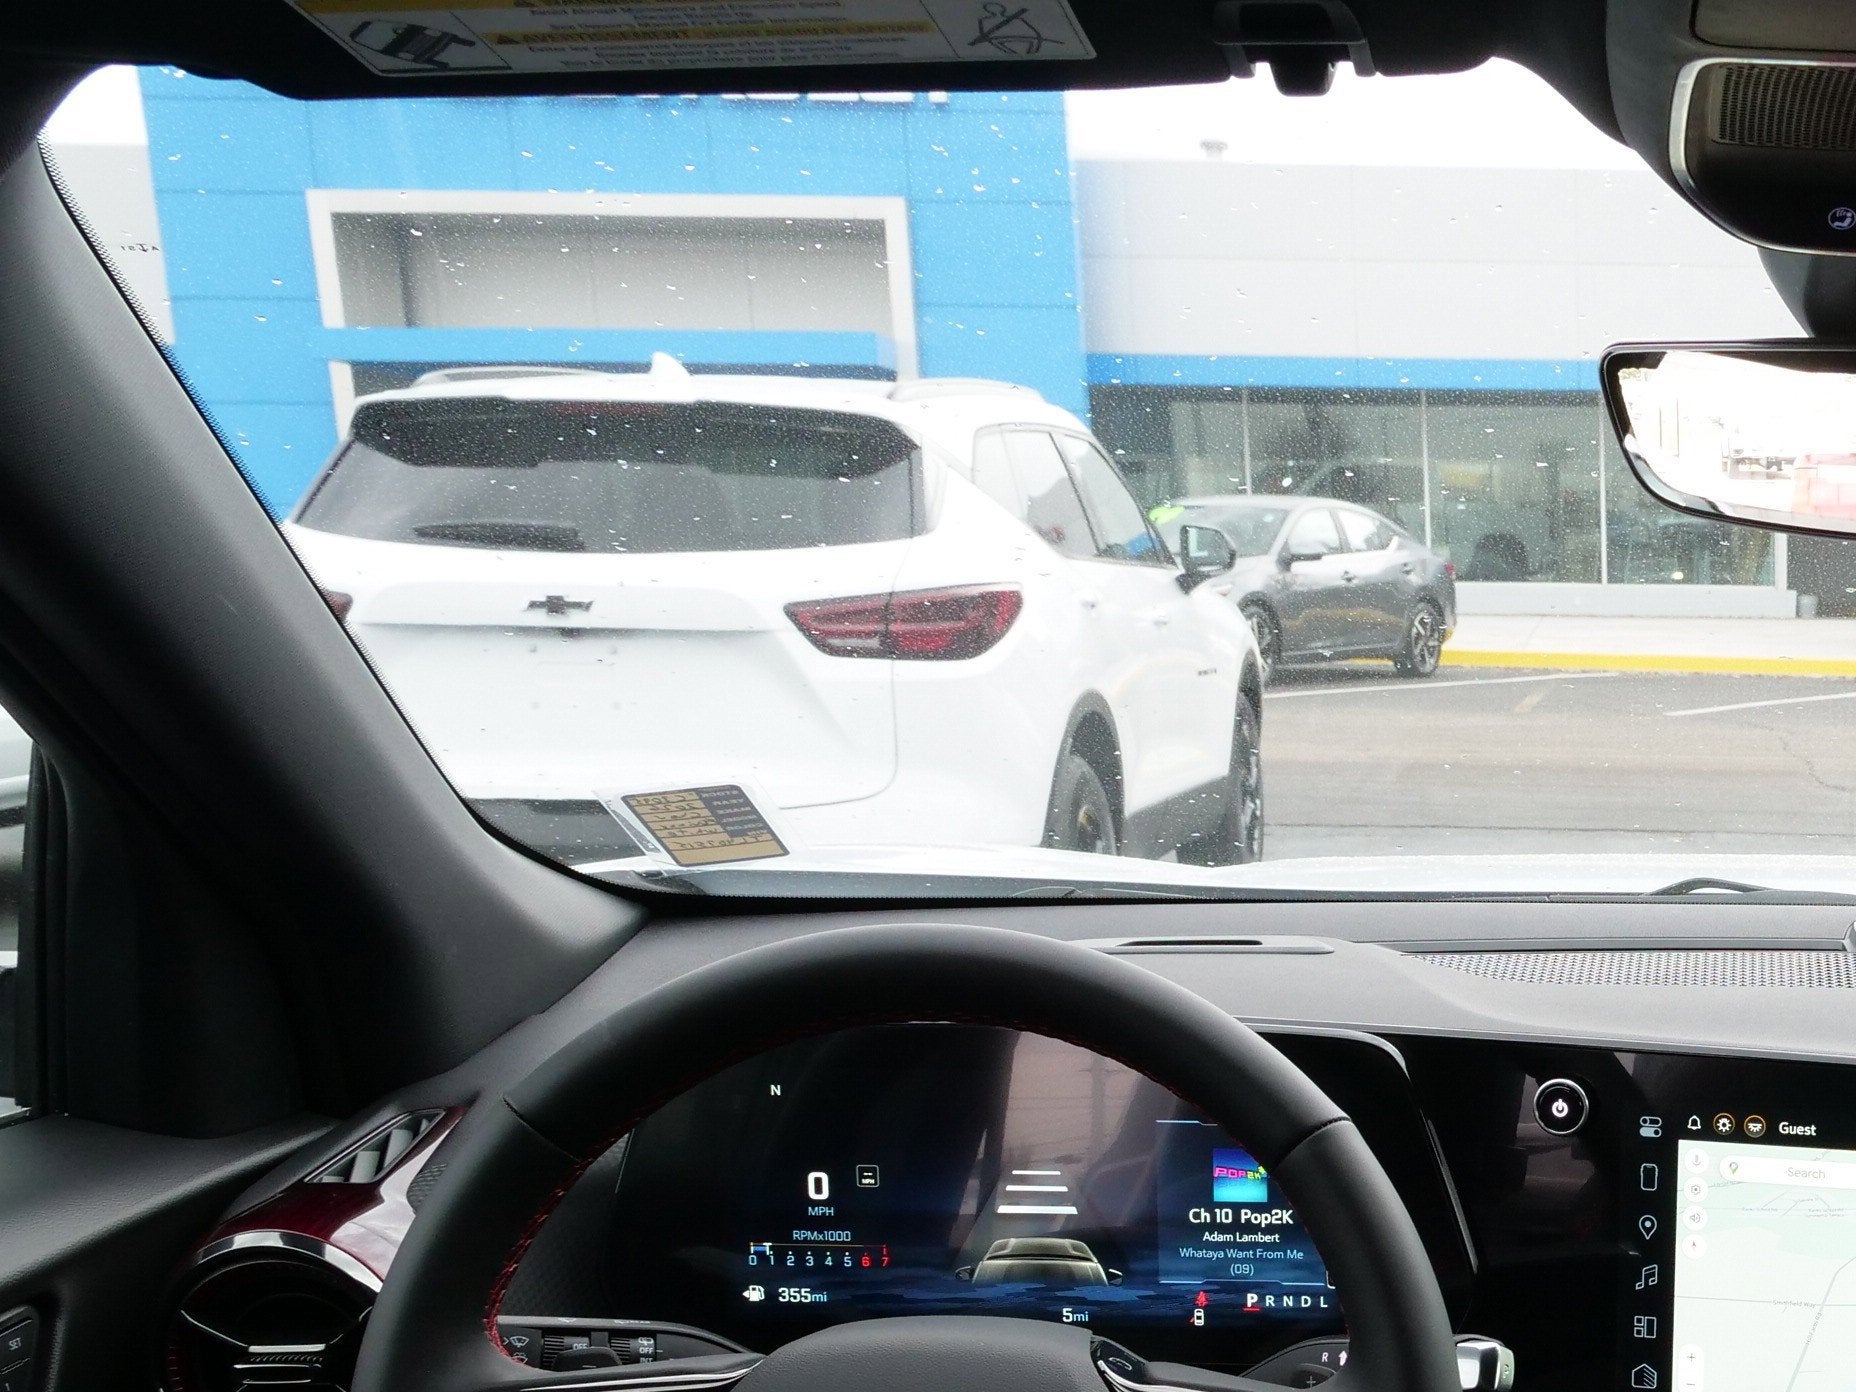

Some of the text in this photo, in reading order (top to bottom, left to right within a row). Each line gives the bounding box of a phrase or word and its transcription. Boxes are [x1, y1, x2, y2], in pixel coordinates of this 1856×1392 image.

[770, 1084, 782, 1096] N
[1778, 1119, 1817, 1138] Guest
[1787, 1166, 1826, 1182] Search
[807, 1171, 830, 1200] 0
[808, 1206, 834, 1217] MPH
[1189, 1208, 1294, 1227] Ch 10 Pop2K
[792, 1230, 852, 1242] RPMx1000
[1202, 1231, 1280, 1243] Adam Lambert
[786, 1256, 795, 1266] 2
[806, 1256, 814, 1266] 3
[824, 1256, 833, 1266] 4
[844, 1256, 852, 1266] 5
[1179, 1248, 1304, 1261] Whataya Want From Me
[1230, 1263, 1254, 1276] (09)
[1247, 1293, 1328, 1307] P R N D L
[8, 1337, 22, 1351] SET
[1321, 1351, 1329, 1363] R
